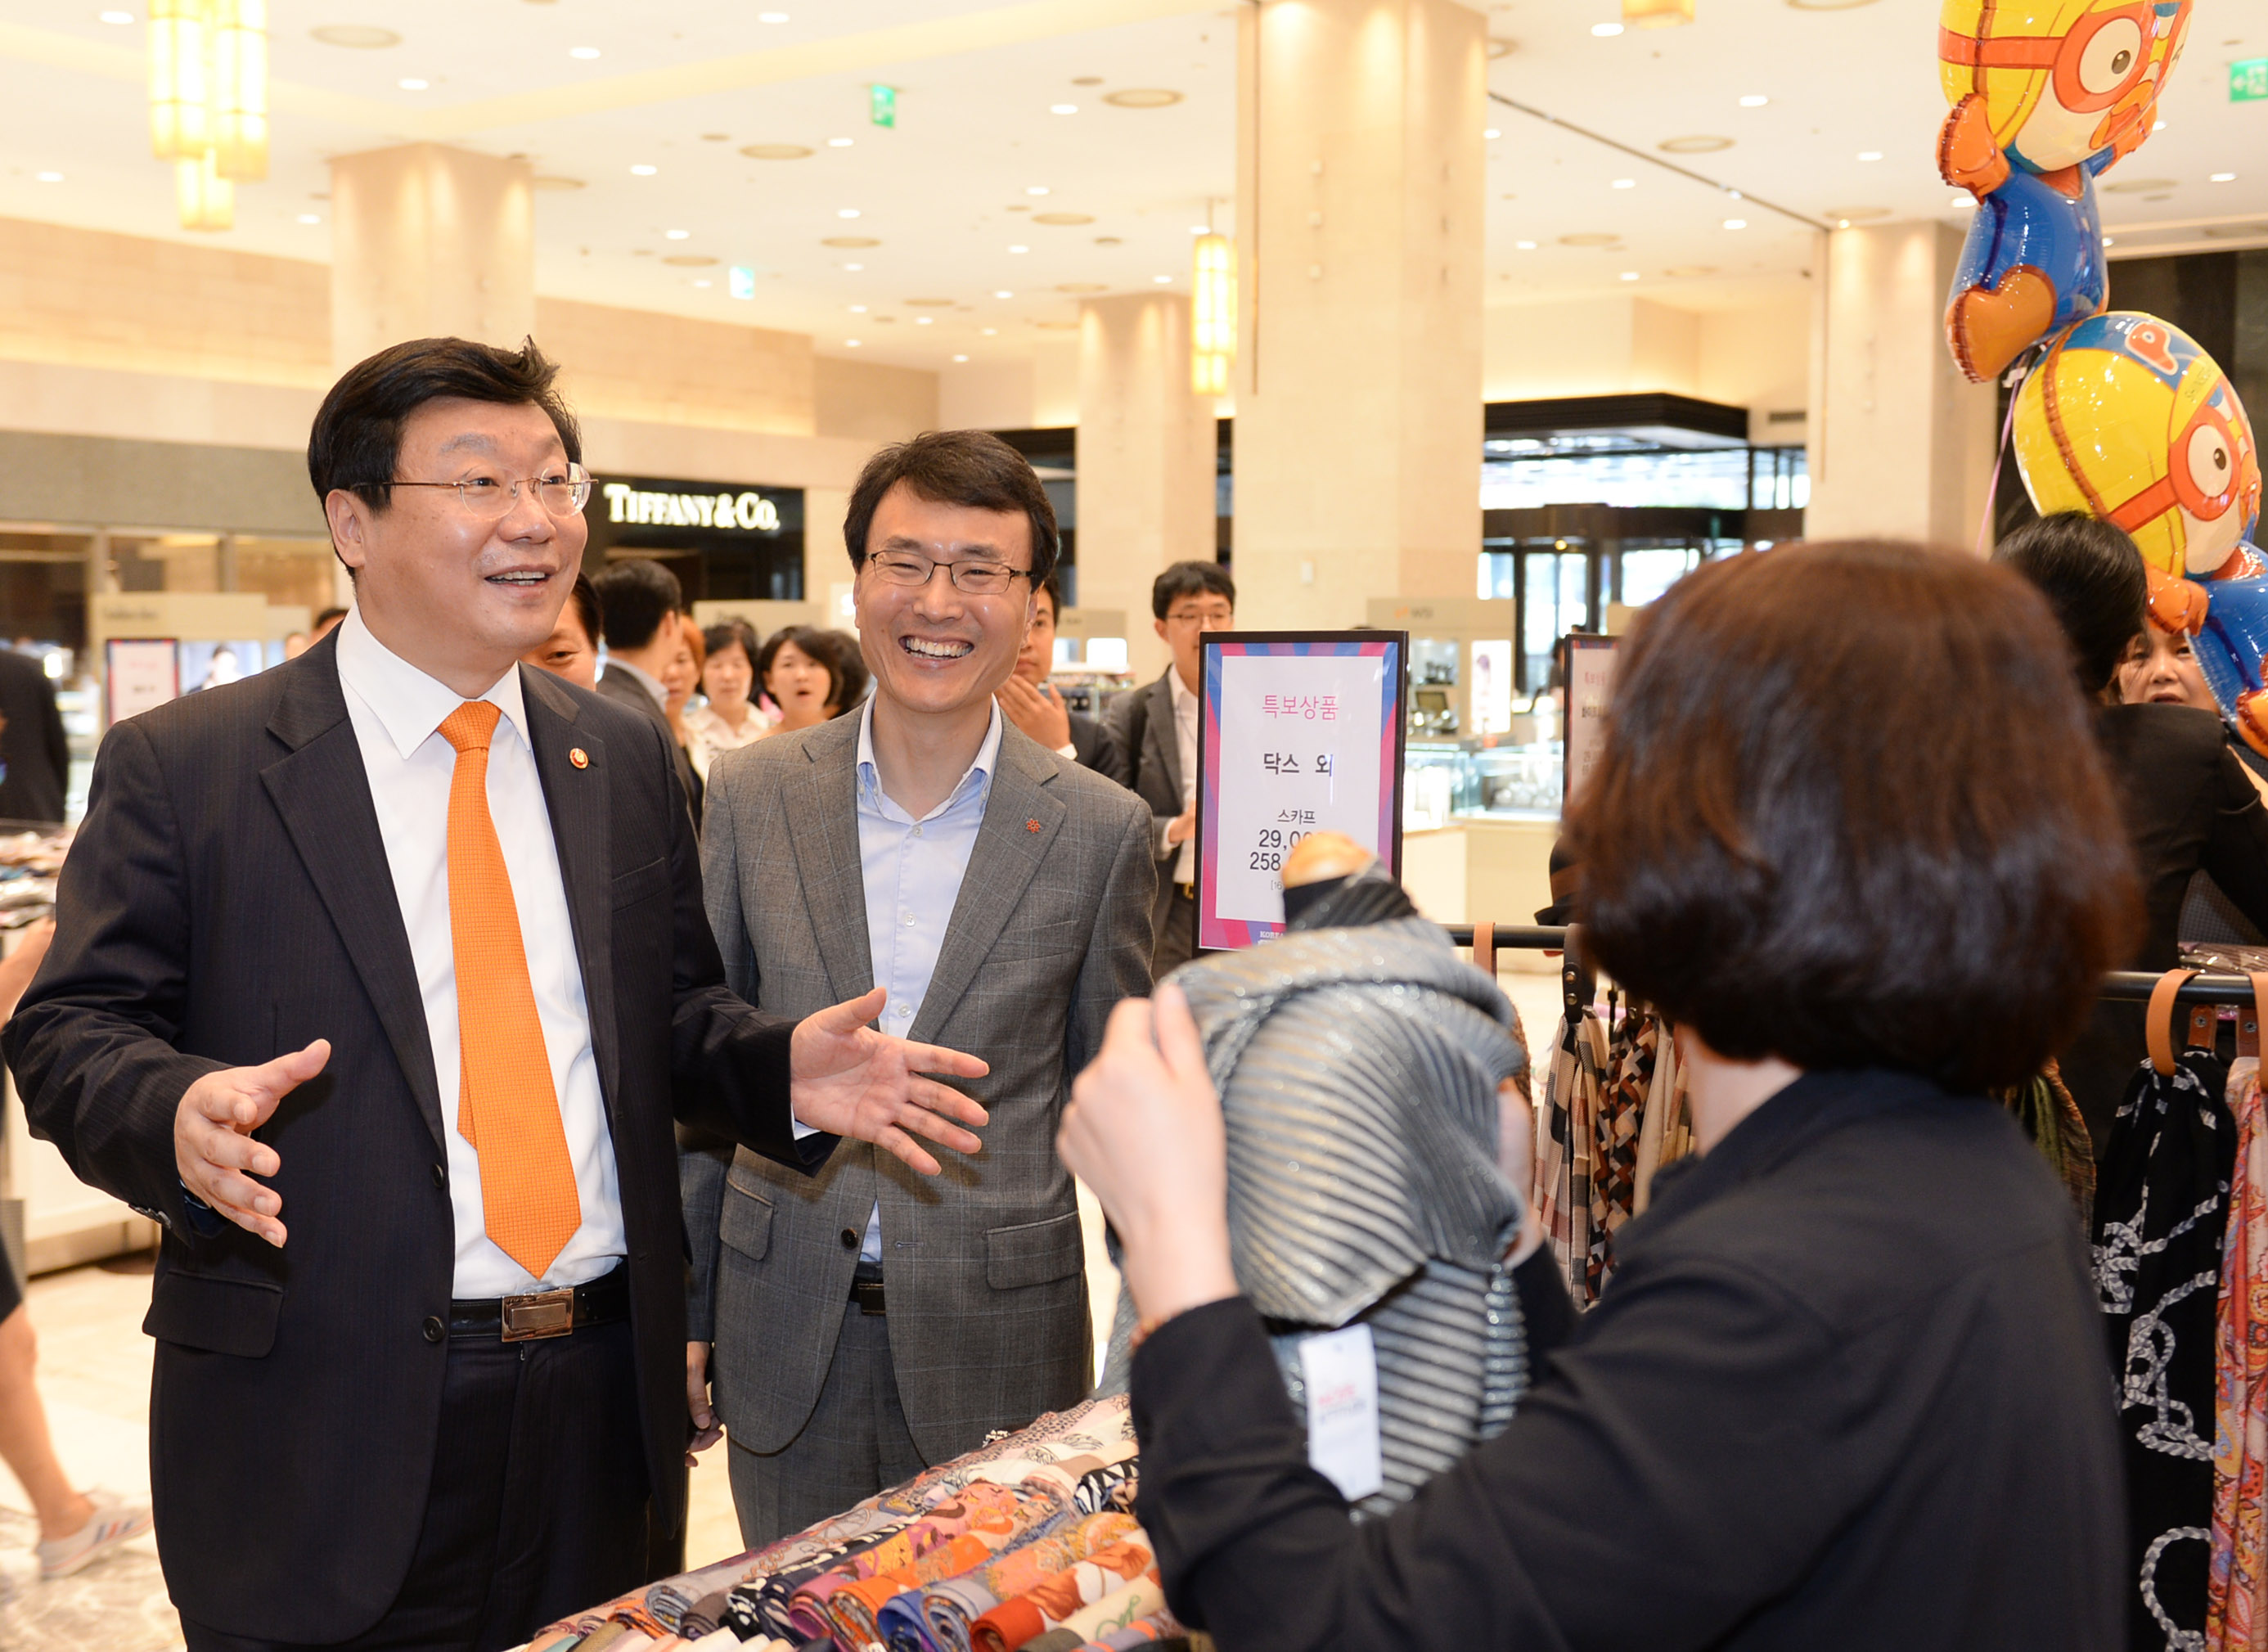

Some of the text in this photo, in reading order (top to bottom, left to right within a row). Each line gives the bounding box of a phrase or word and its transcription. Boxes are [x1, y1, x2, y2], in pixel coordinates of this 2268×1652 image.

[1262, 695, 1339, 721] 특보상품
[1263, 752, 1334, 777] 닥스 외
[1277, 808, 1316, 826] 스카프
[1258, 828, 1314, 851] 29,0
[1249, 851, 1293, 871] 258
